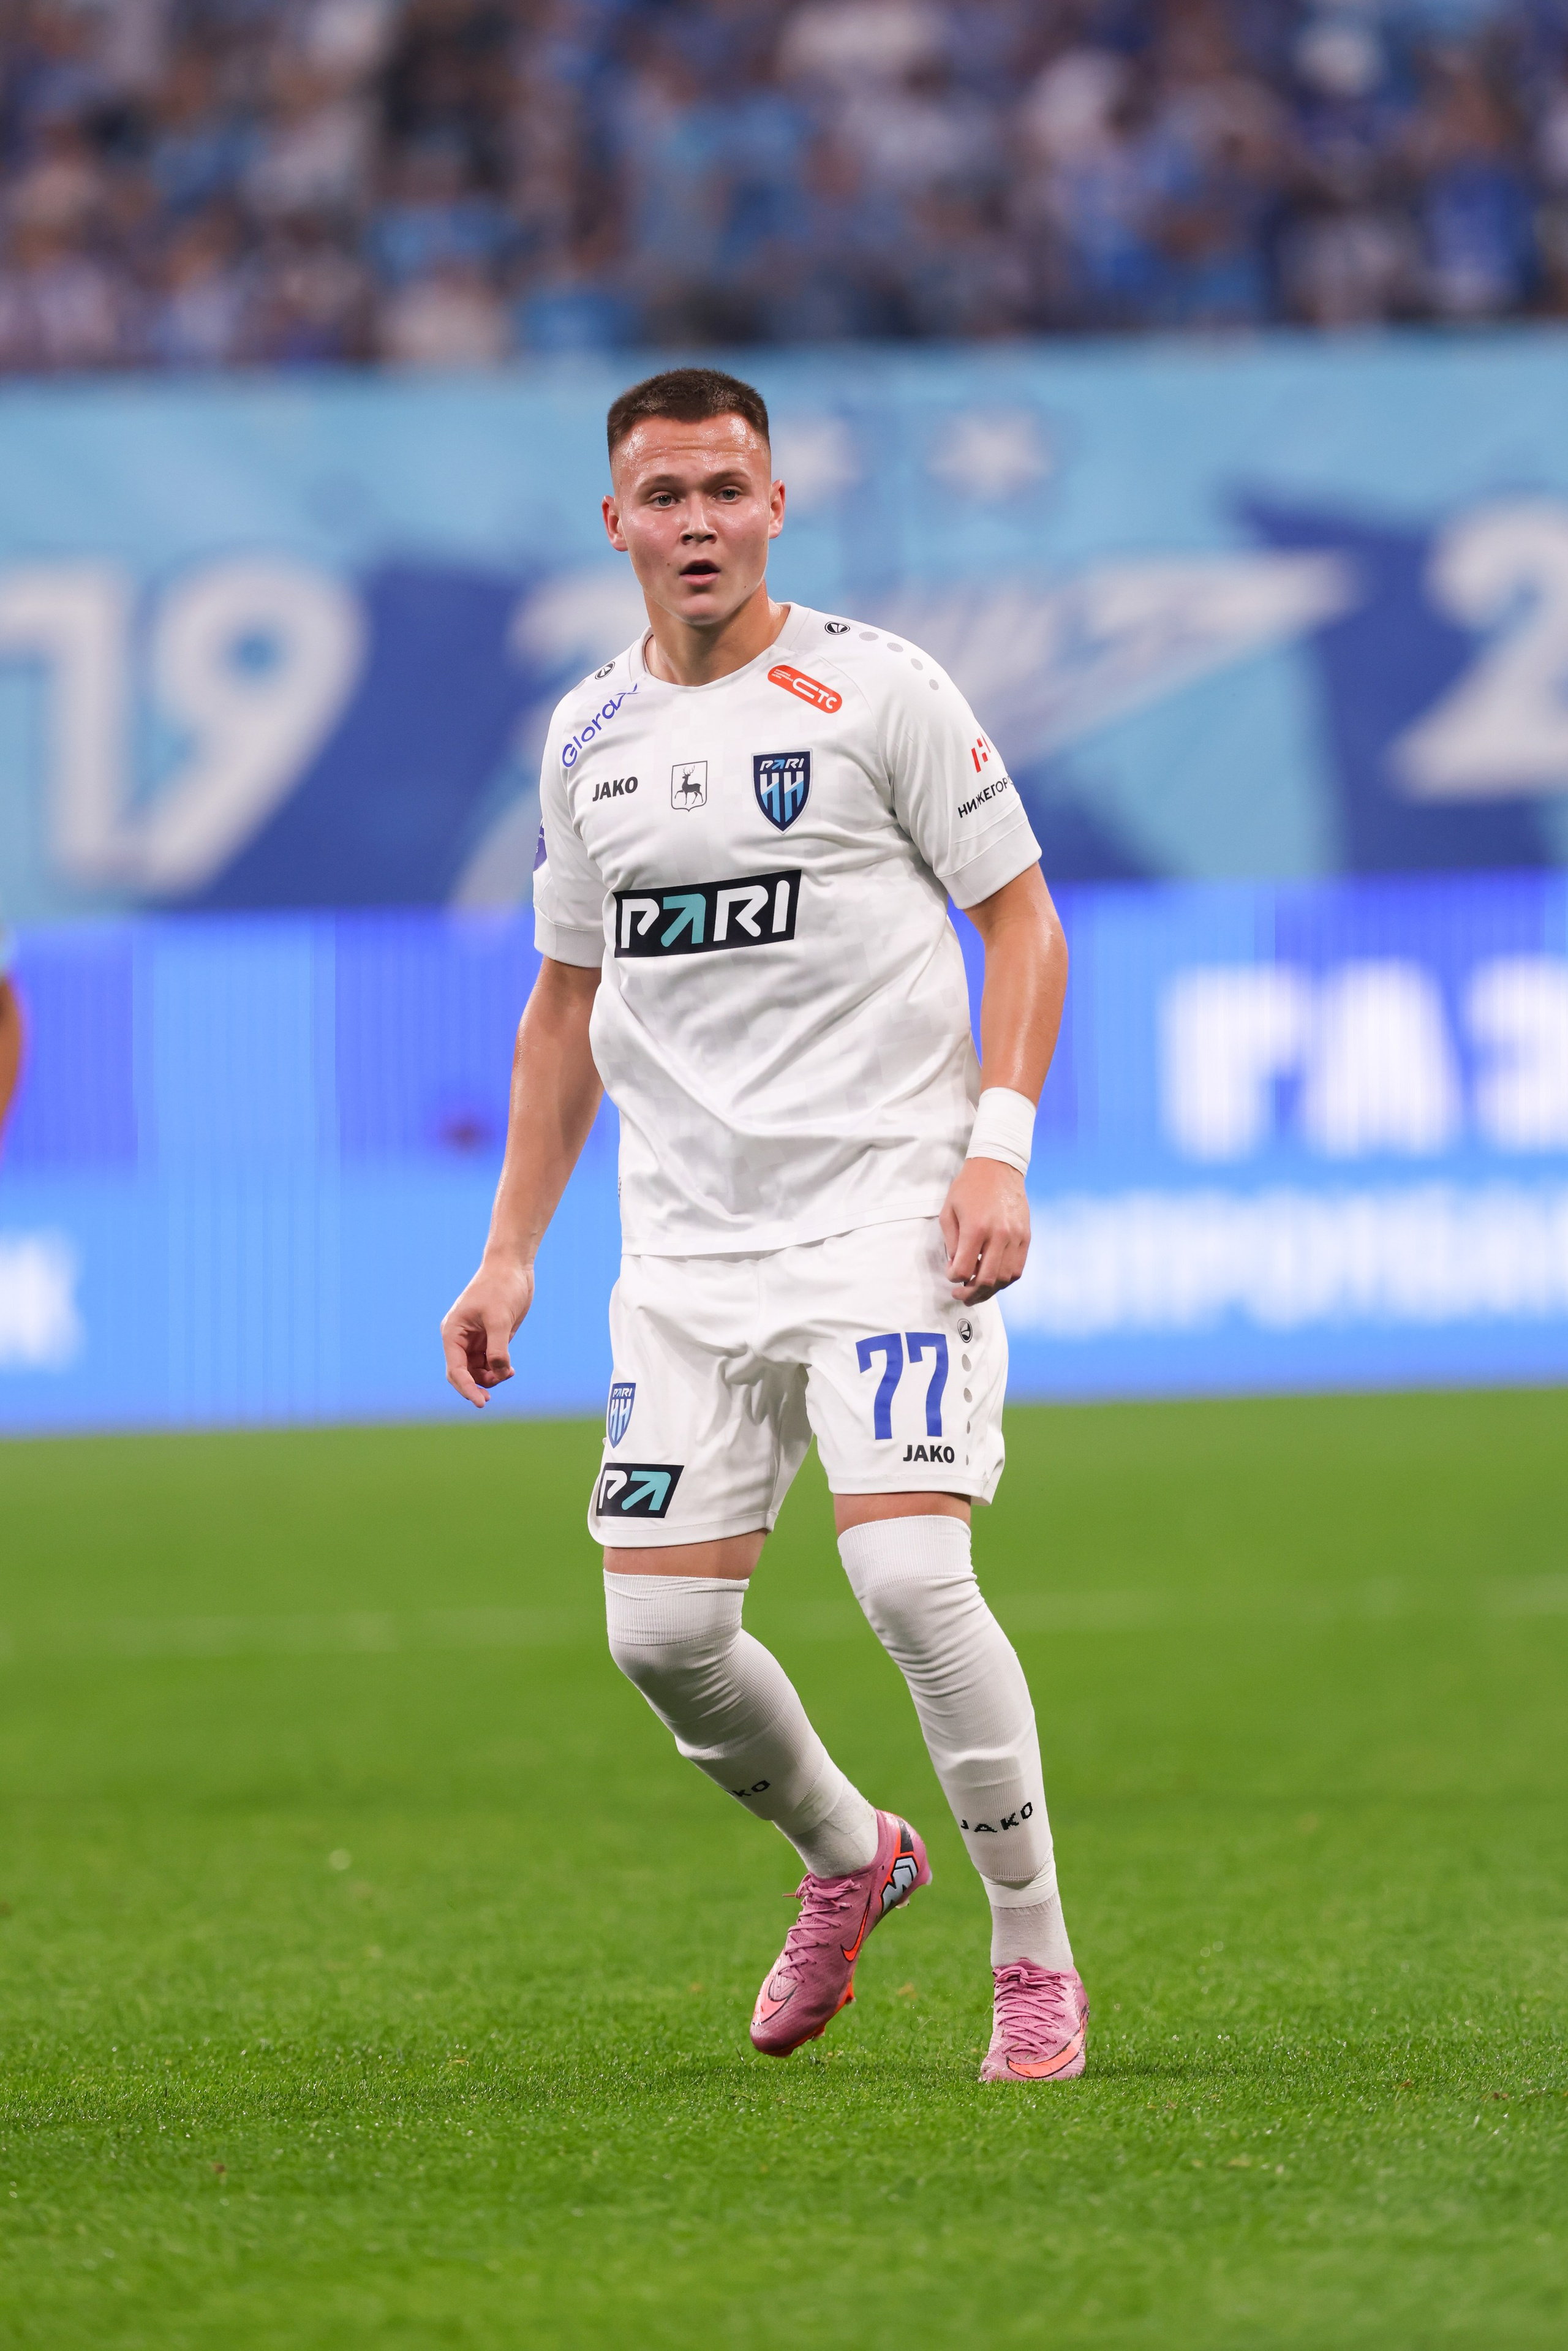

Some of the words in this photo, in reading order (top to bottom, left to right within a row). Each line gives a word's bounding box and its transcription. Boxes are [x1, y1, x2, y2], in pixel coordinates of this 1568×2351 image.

[592, 776, 638, 802] JAKO
[620, 880, 790, 949] PARI
[856, 1332, 949, 1440] 77
[903, 1444, 955, 1463] JAKO
[720, 1779, 771, 1797] KO
[960, 1802, 1033, 1833] JAKO
